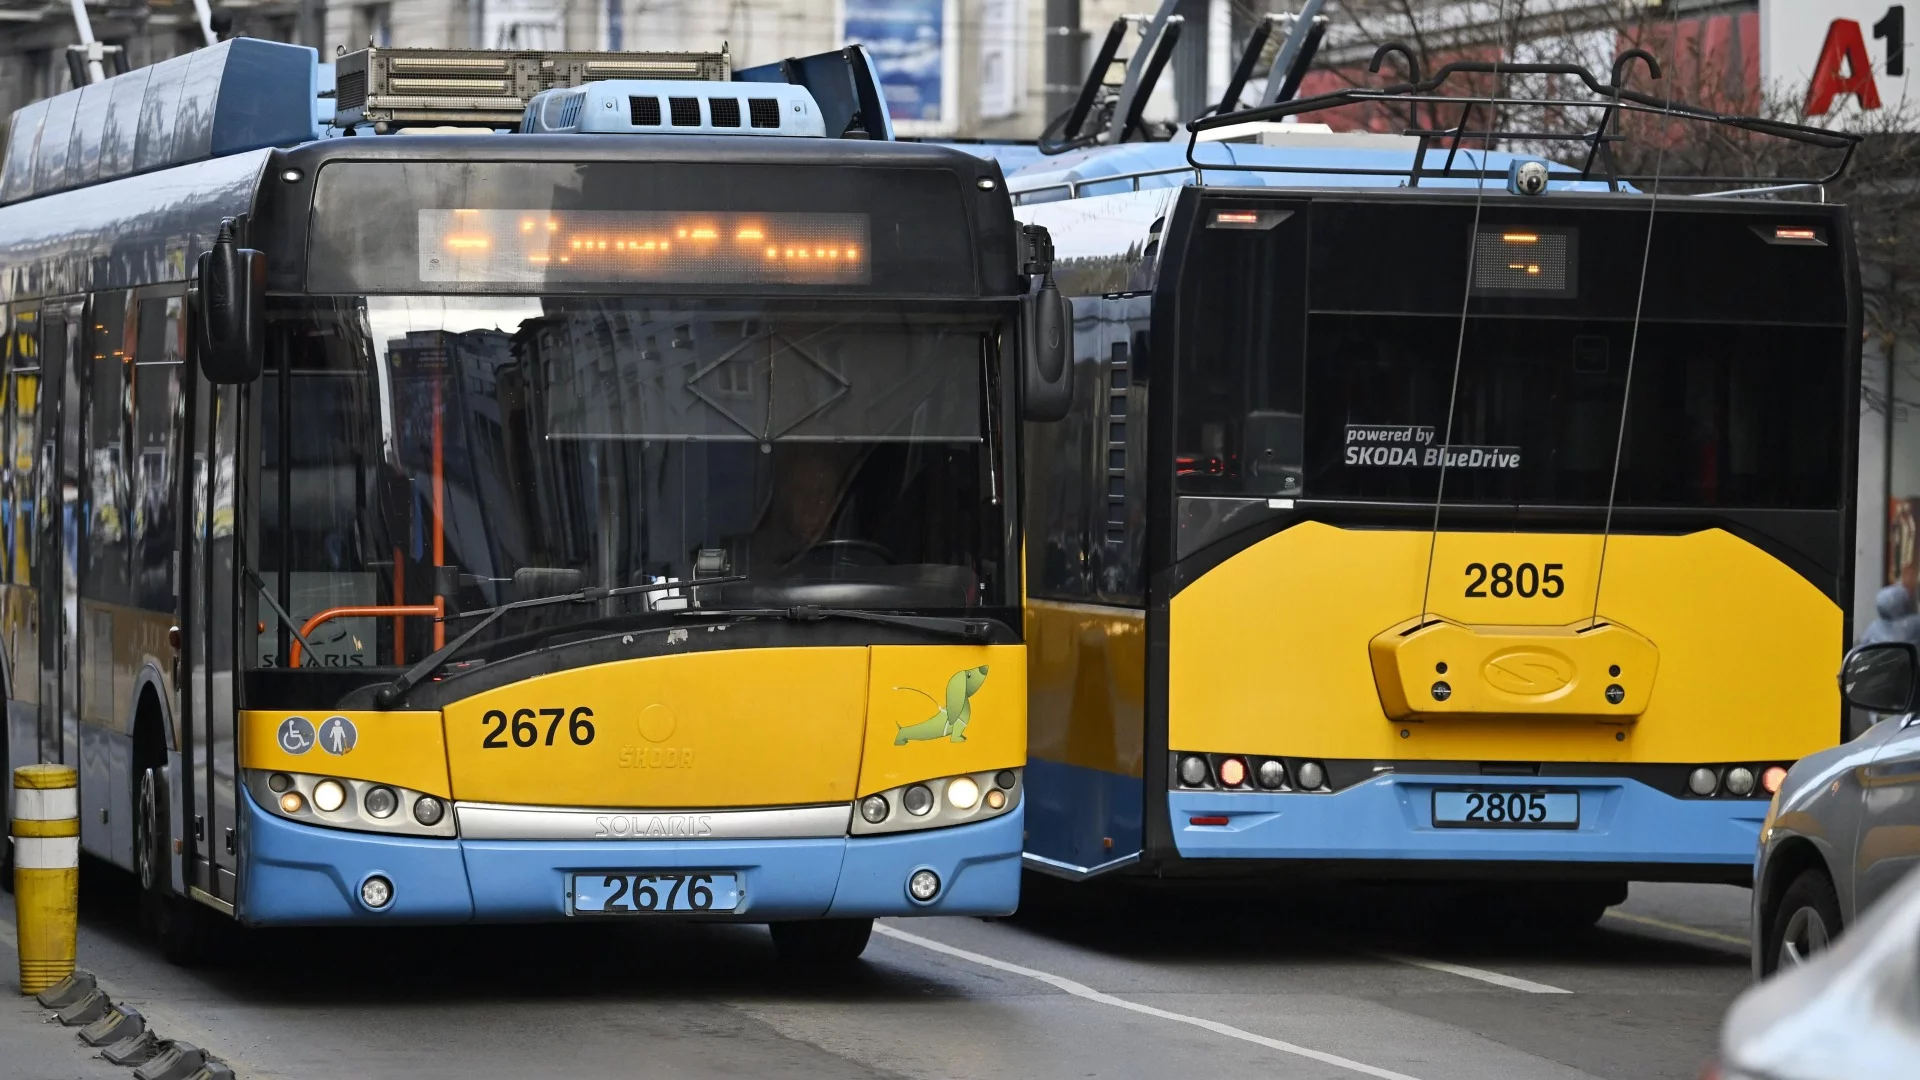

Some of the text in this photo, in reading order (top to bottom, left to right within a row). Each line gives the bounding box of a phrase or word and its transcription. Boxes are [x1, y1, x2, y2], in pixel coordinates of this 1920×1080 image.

[1802, 5, 1904, 117] A1
[1346, 427, 1434, 446] powered by
[1345, 446, 1521, 468] SKODA BlueDrive
[1464, 562, 1565, 598] 2805
[262, 654, 364, 667] SARIS
[482, 706, 596, 749] 2676
[1466, 793, 1547, 822] 2805
[594, 816, 712, 837] SOLARIS
[603, 875, 713, 911] 2676
